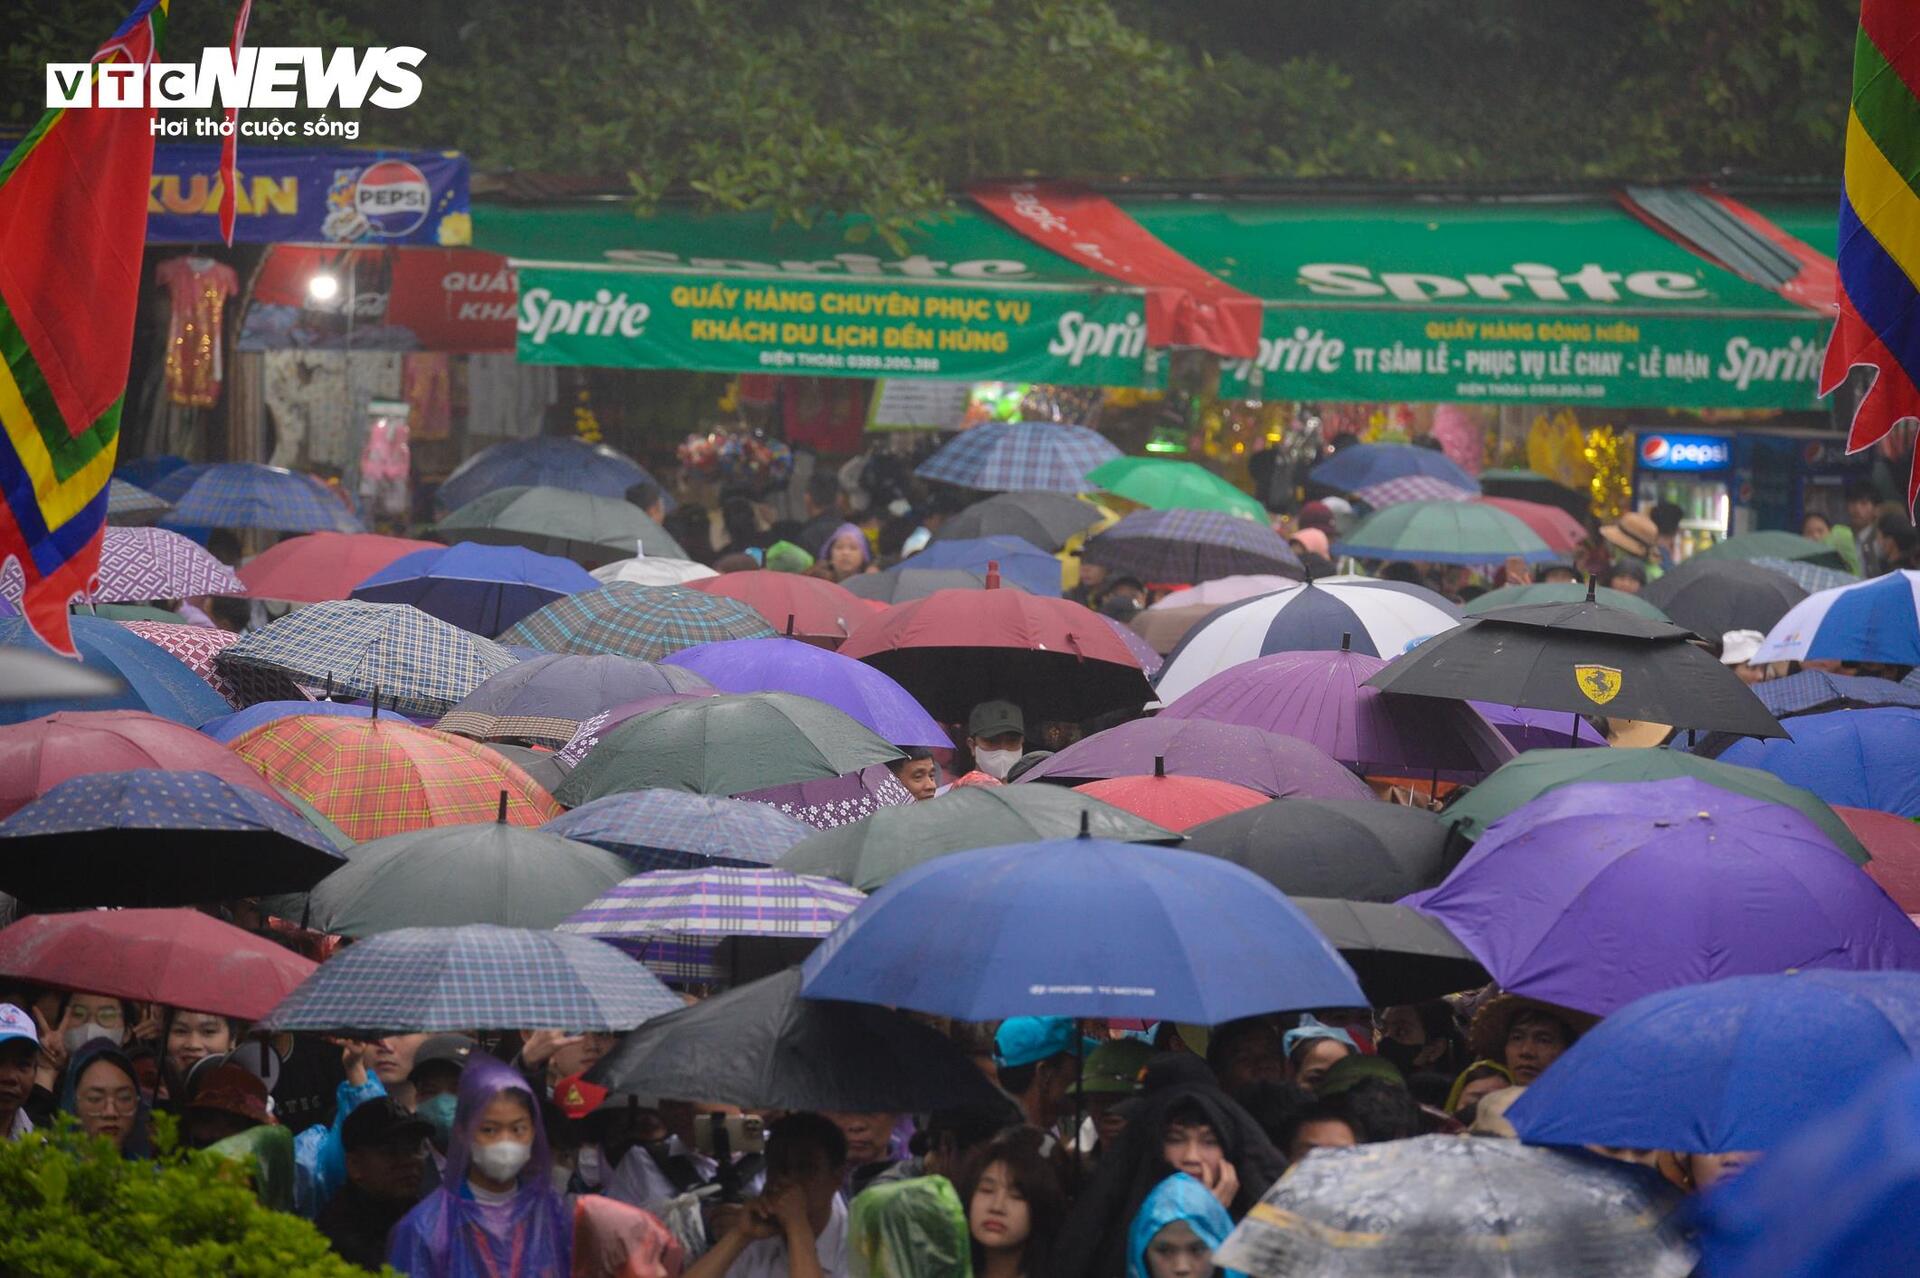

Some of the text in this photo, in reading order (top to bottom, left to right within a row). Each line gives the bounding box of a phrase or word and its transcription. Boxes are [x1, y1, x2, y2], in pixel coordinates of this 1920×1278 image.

[360, 190, 426, 206] PEPSI
[1298, 262, 1709, 301] Sprite
[517, 287, 650, 344] Sprite
[744, 283, 816, 313] HÀNG
[820, 291, 921, 316] CHUYÊN
[924, 296, 990, 323] PHỤC
[995, 301, 1032, 325] VỤ
[691, 315, 778, 344] KHÁCH
[781, 321, 818, 345] DU
[822, 323, 877, 349] LỊCH
[938, 327, 1009, 353] HÙNG
[1465, 349, 1517, 380] PHỤC
[1520, 350, 1546, 381] VỤ
[1574, 351, 1624, 377] CHAY
[1670, 442, 1729, 466] pepsi
